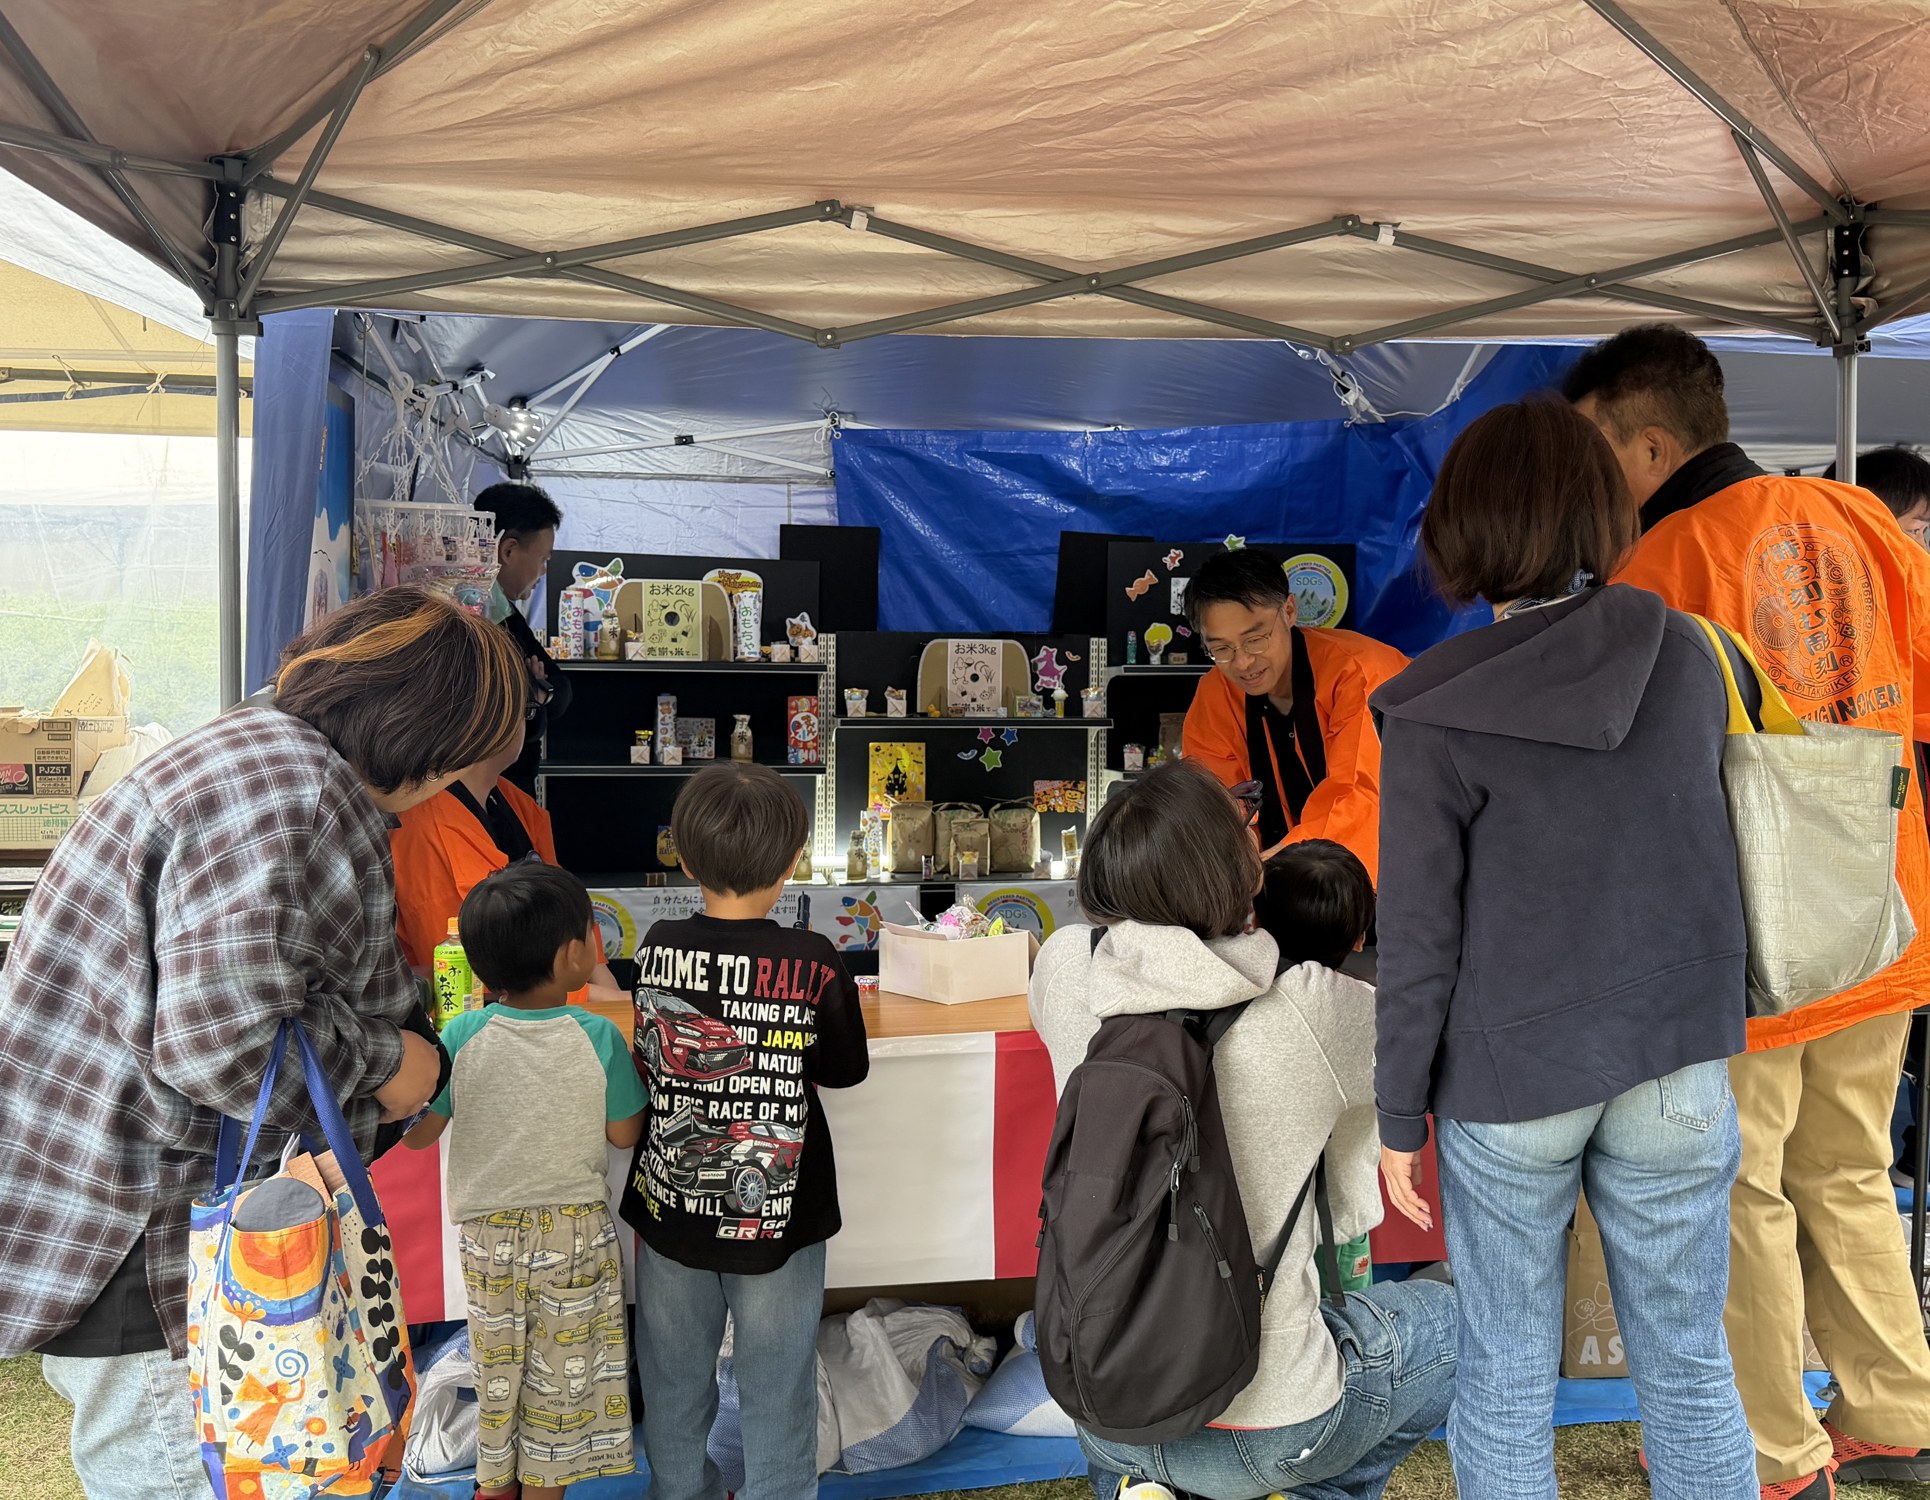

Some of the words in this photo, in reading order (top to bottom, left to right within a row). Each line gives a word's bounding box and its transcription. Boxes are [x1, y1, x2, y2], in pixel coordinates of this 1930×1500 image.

[649, 583, 695, 597] お米2kg
[1296, 577, 1323, 586] SDGs
[741, 605, 755, 651] おもちゃ
[954, 642, 997, 656] お米3kg
[38, 766, 68, 775] PJZ5T
[717, 954, 750, 996] TO
[754, 957, 836, 1006] RALLY
[721, 999, 780, 1022] TAKING
[728, 1075, 771, 1095] OPEN
[708, 1100, 753, 1120] RACE
[758, 1102, 780, 1120] OF
[684, 1197, 724, 1217] WILL
[718, 1226, 758, 1239] GR
